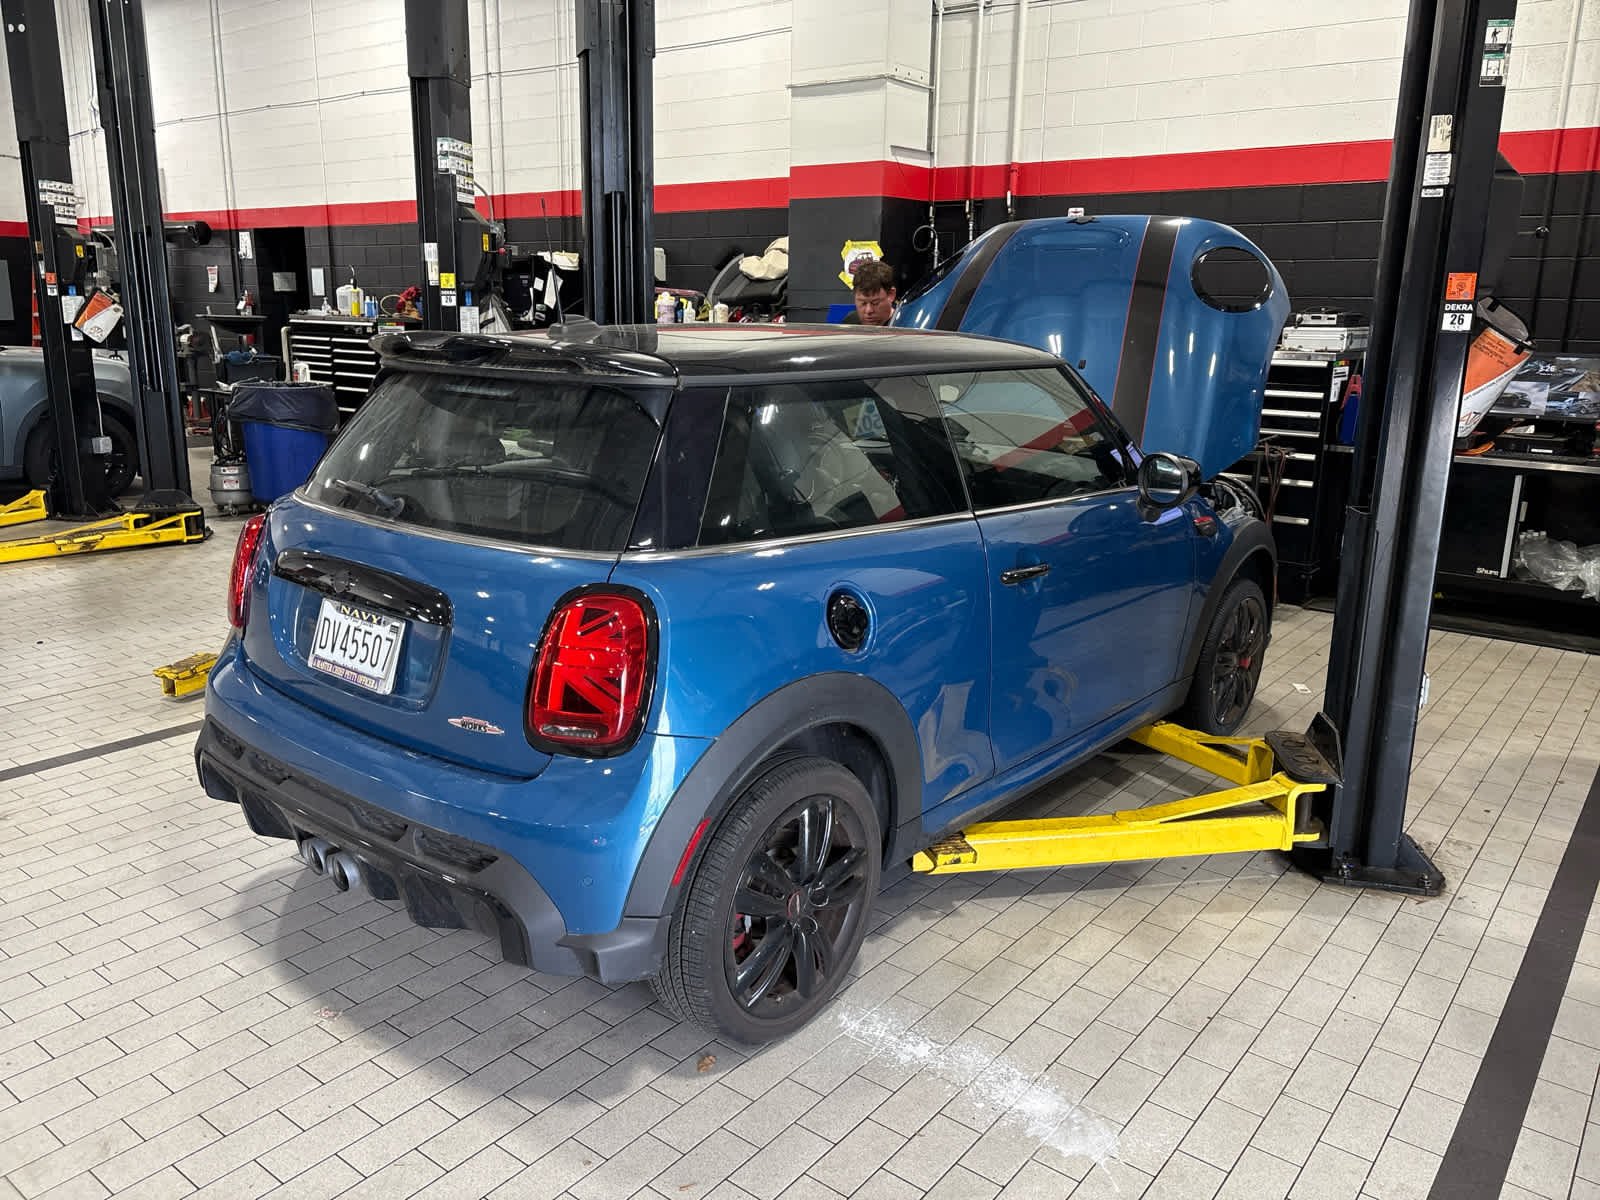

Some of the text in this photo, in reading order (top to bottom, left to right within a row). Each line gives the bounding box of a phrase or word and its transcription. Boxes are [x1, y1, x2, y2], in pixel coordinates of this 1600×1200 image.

[1445, 303, 1474, 311] DEKRA
[1450, 313, 1465, 325] 26
[341, 604, 381, 625] NAVY
[318, 616, 395, 671] DV45507
[460, 719, 487, 732] WORKS
